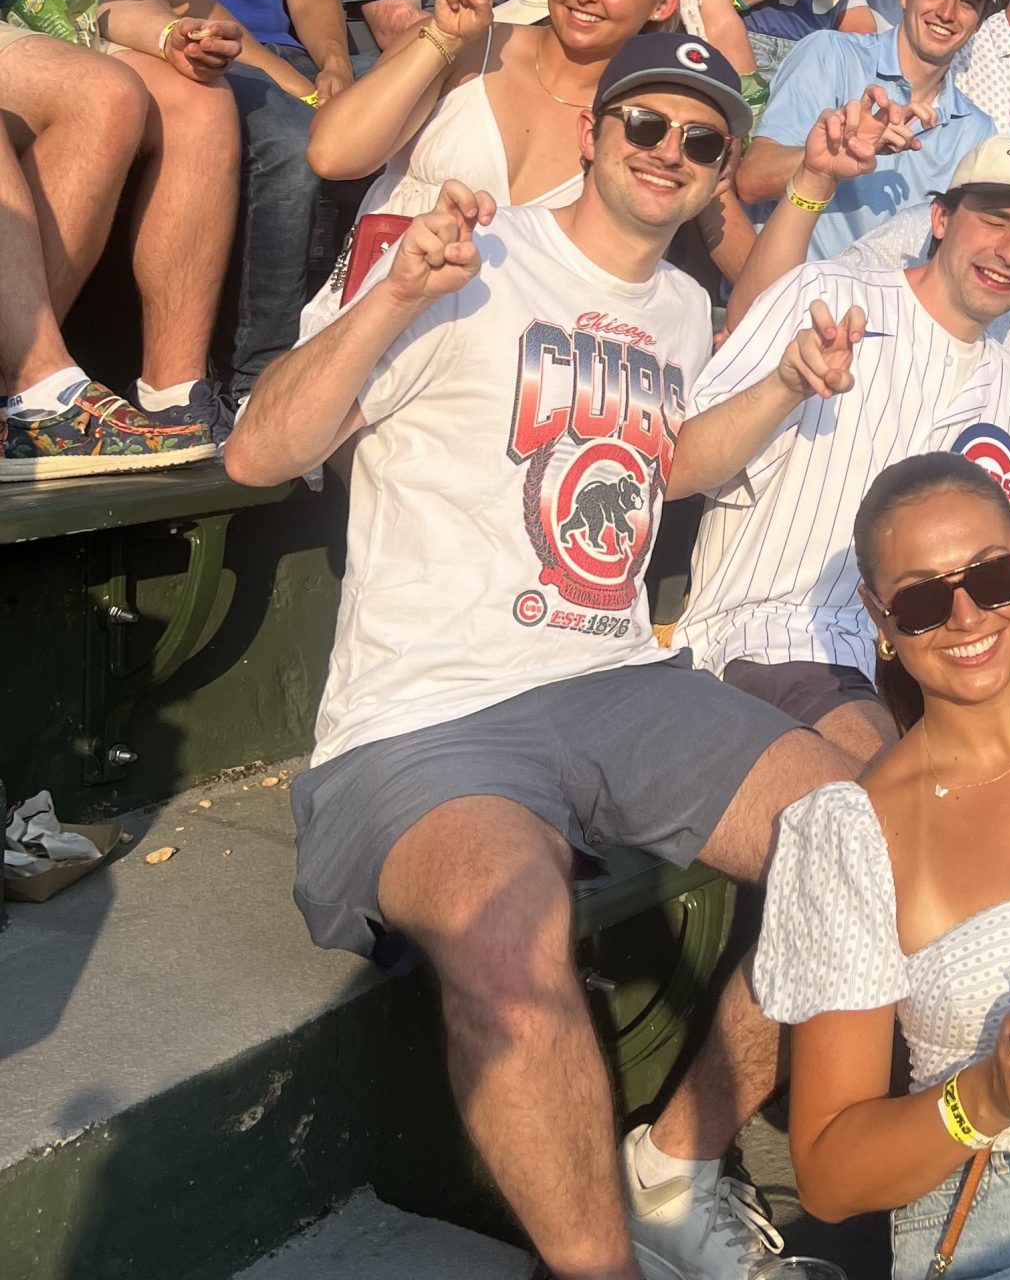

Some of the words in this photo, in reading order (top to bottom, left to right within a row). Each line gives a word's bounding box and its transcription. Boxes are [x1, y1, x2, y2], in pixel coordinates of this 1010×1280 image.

[675, 42, 711, 72] C
[575, 310, 656, 346] Chicago
[585, 613, 631, 638] 1876
